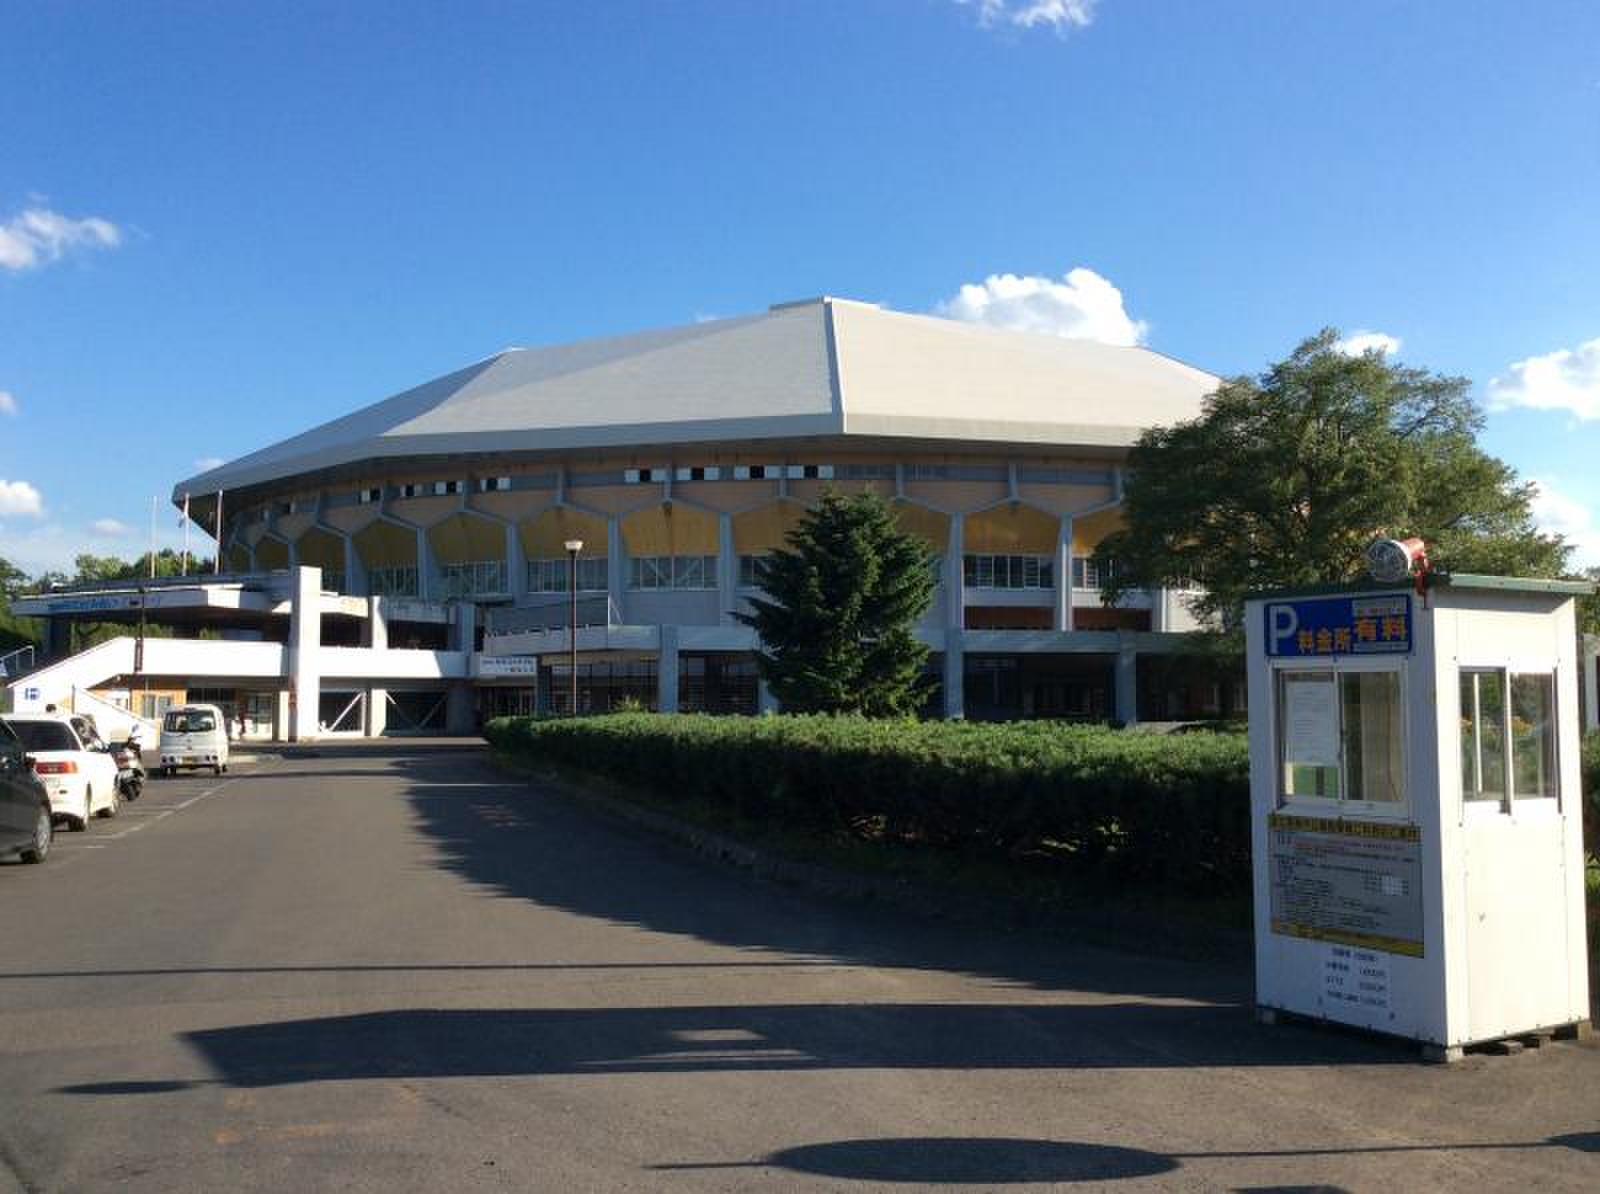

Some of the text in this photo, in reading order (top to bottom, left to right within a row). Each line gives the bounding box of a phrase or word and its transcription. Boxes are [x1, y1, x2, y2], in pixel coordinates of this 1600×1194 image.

[1269, 604, 1298, 654] P
[1298, 627, 1351, 654] 料金所
